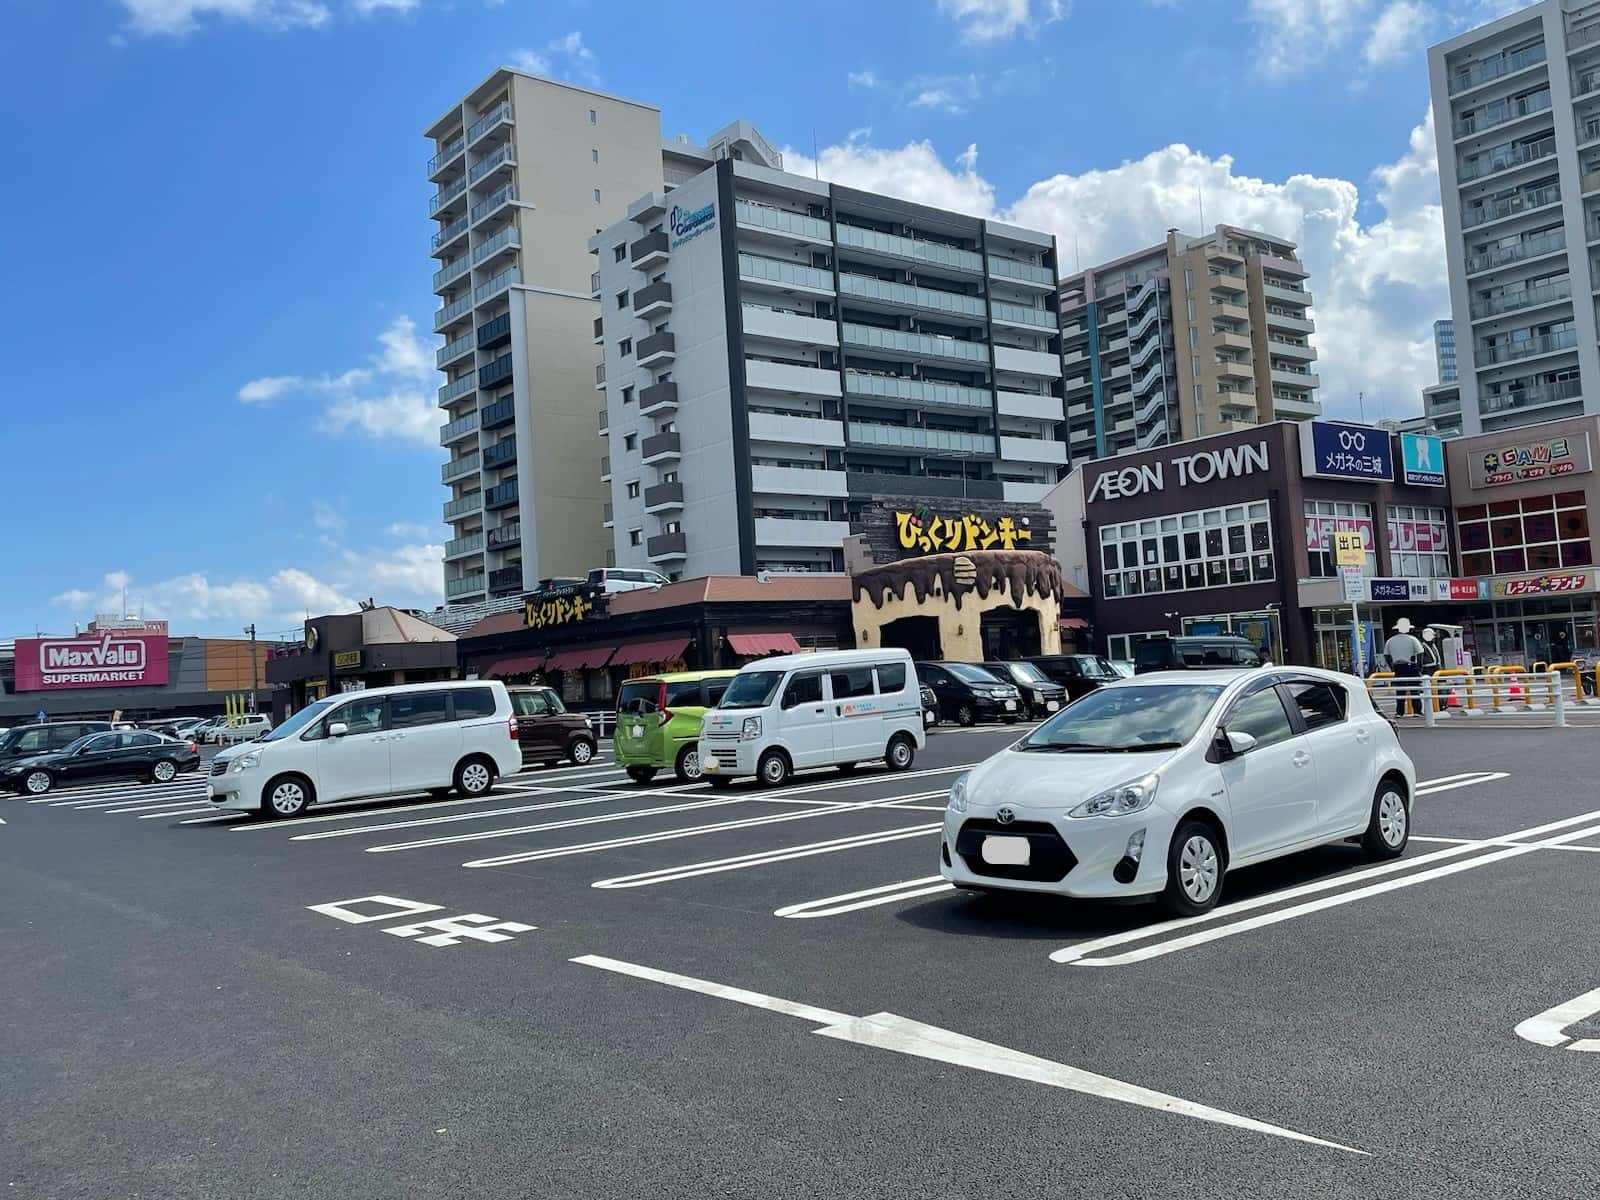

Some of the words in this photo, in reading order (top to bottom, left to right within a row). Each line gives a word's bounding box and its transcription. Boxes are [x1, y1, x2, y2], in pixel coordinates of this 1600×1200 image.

[1171, 440, 1270, 487] TOWN
[1325, 452, 1383, 475] メガネの三城
[1501, 438, 1570, 467] GAME
[895, 511, 1032, 552] びっくりドンキー
[1338, 535, 1362, 551] 出口
[1373, 585, 1408, 597] メガネの三城
[1506, 575, 1585, 596] レジャーランド
[526, 595, 593, 629] びっくりドンキー
[49, 634, 138, 667] MaxValu
[42, 670, 145, 685] SUPERMARKET
